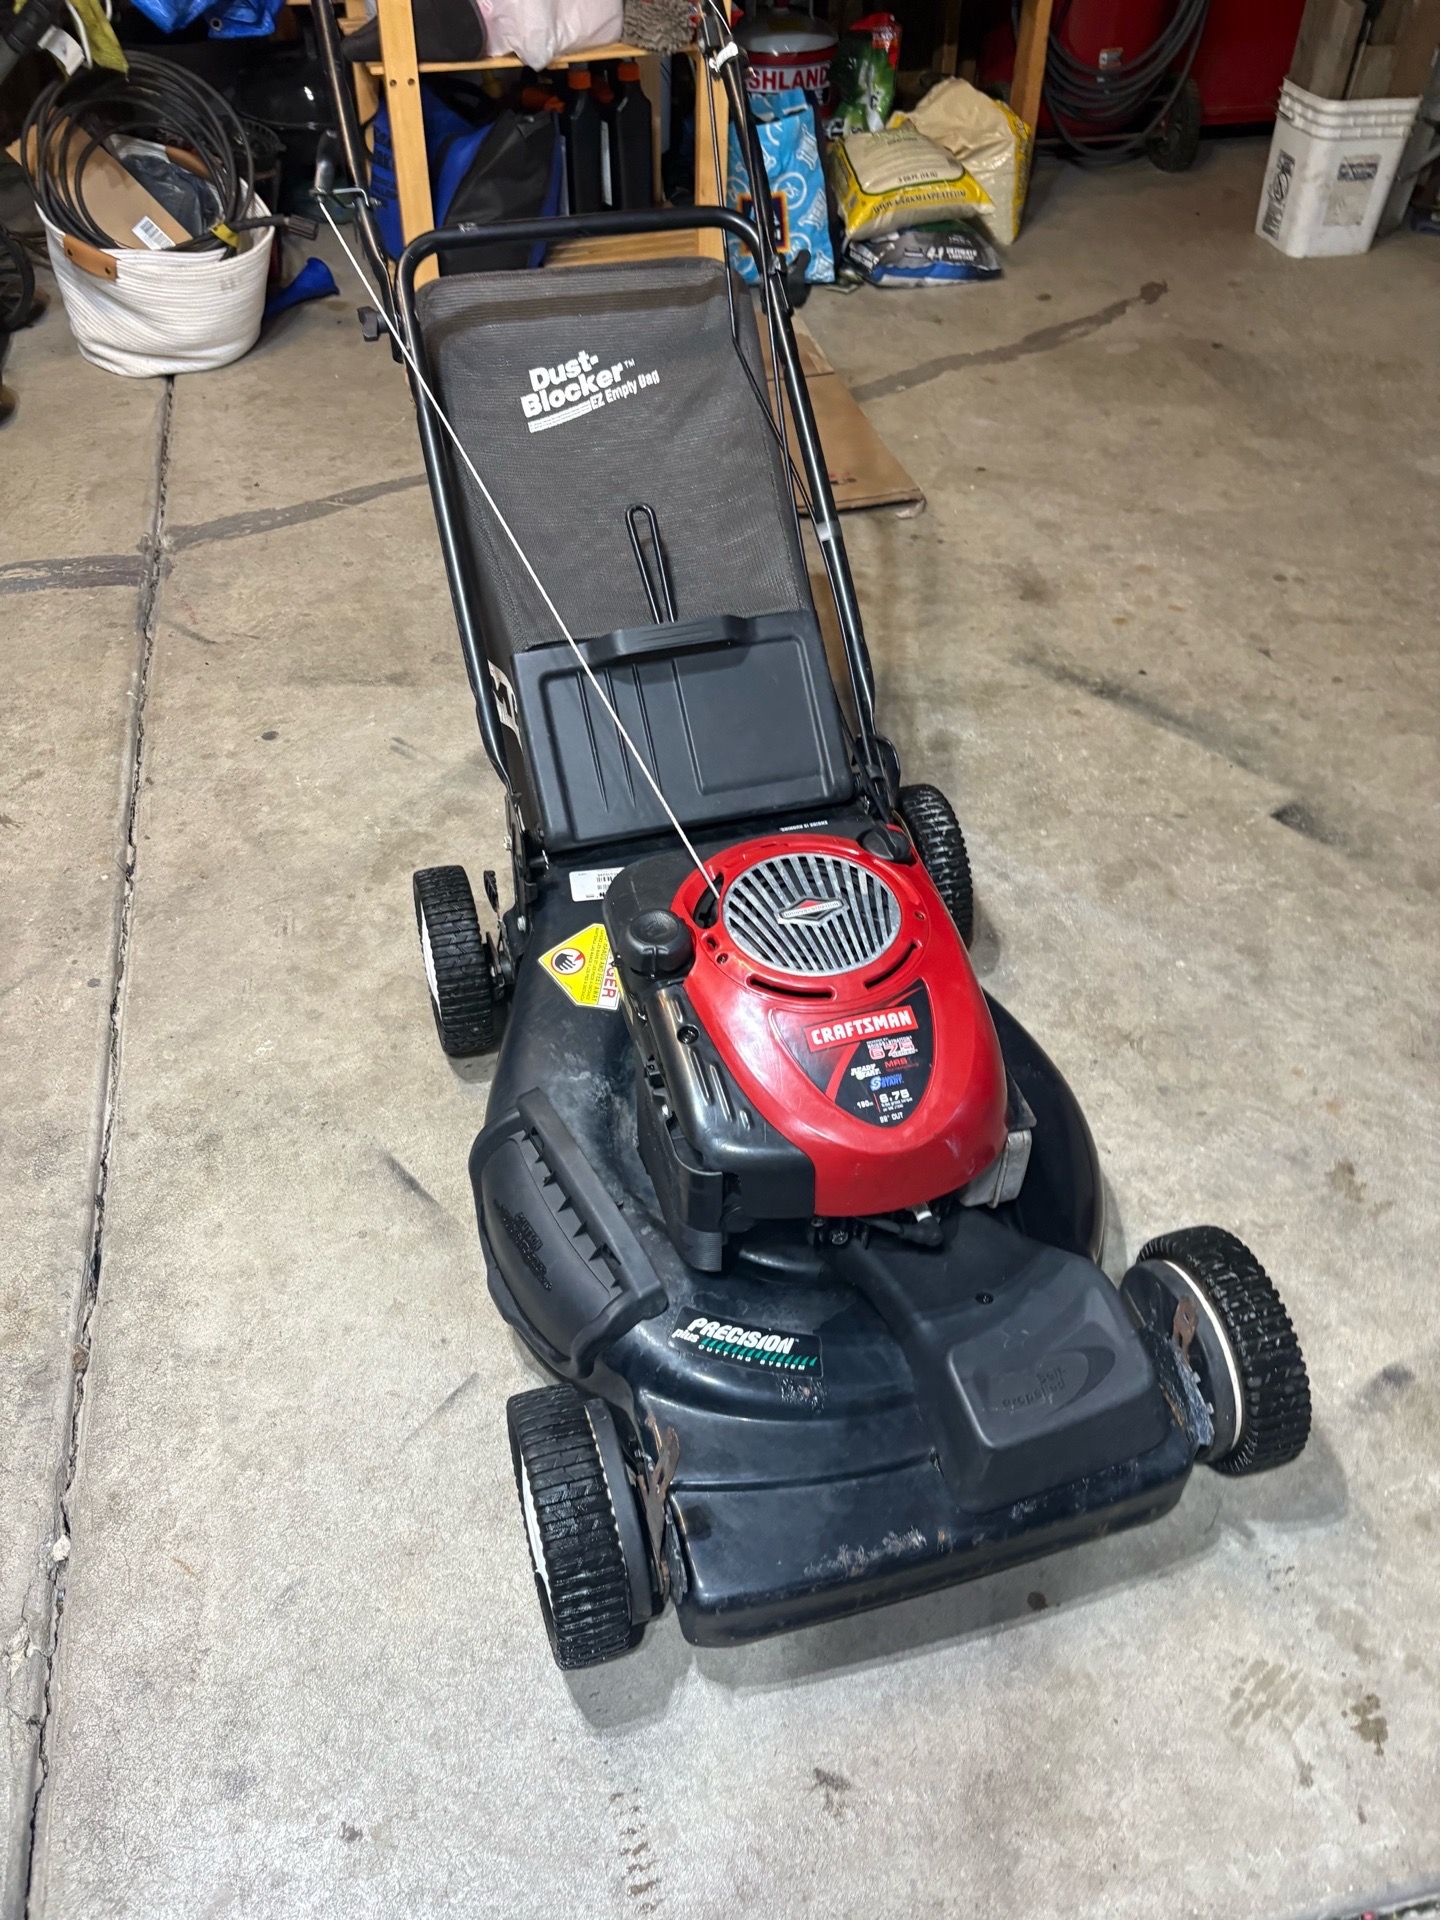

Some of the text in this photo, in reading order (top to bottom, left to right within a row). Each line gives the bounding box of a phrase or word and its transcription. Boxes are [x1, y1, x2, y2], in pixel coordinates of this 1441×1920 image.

[749, 65, 830, 91] SHLAND
[528, 350, 599, 392] Dust-
[520, 362, 624, 418] Blocker
[589, 391, 606, 410] EZ
[604, 379, 638, 404] Empty
[811, 1010, 912, 1045] CRAFTSMAN
[672, 1328, 700, 1343] plus
[687, 1317, 795, 1355] PRECISION
[698, 1344, 806, 1371] CUTTING SYSTEM
